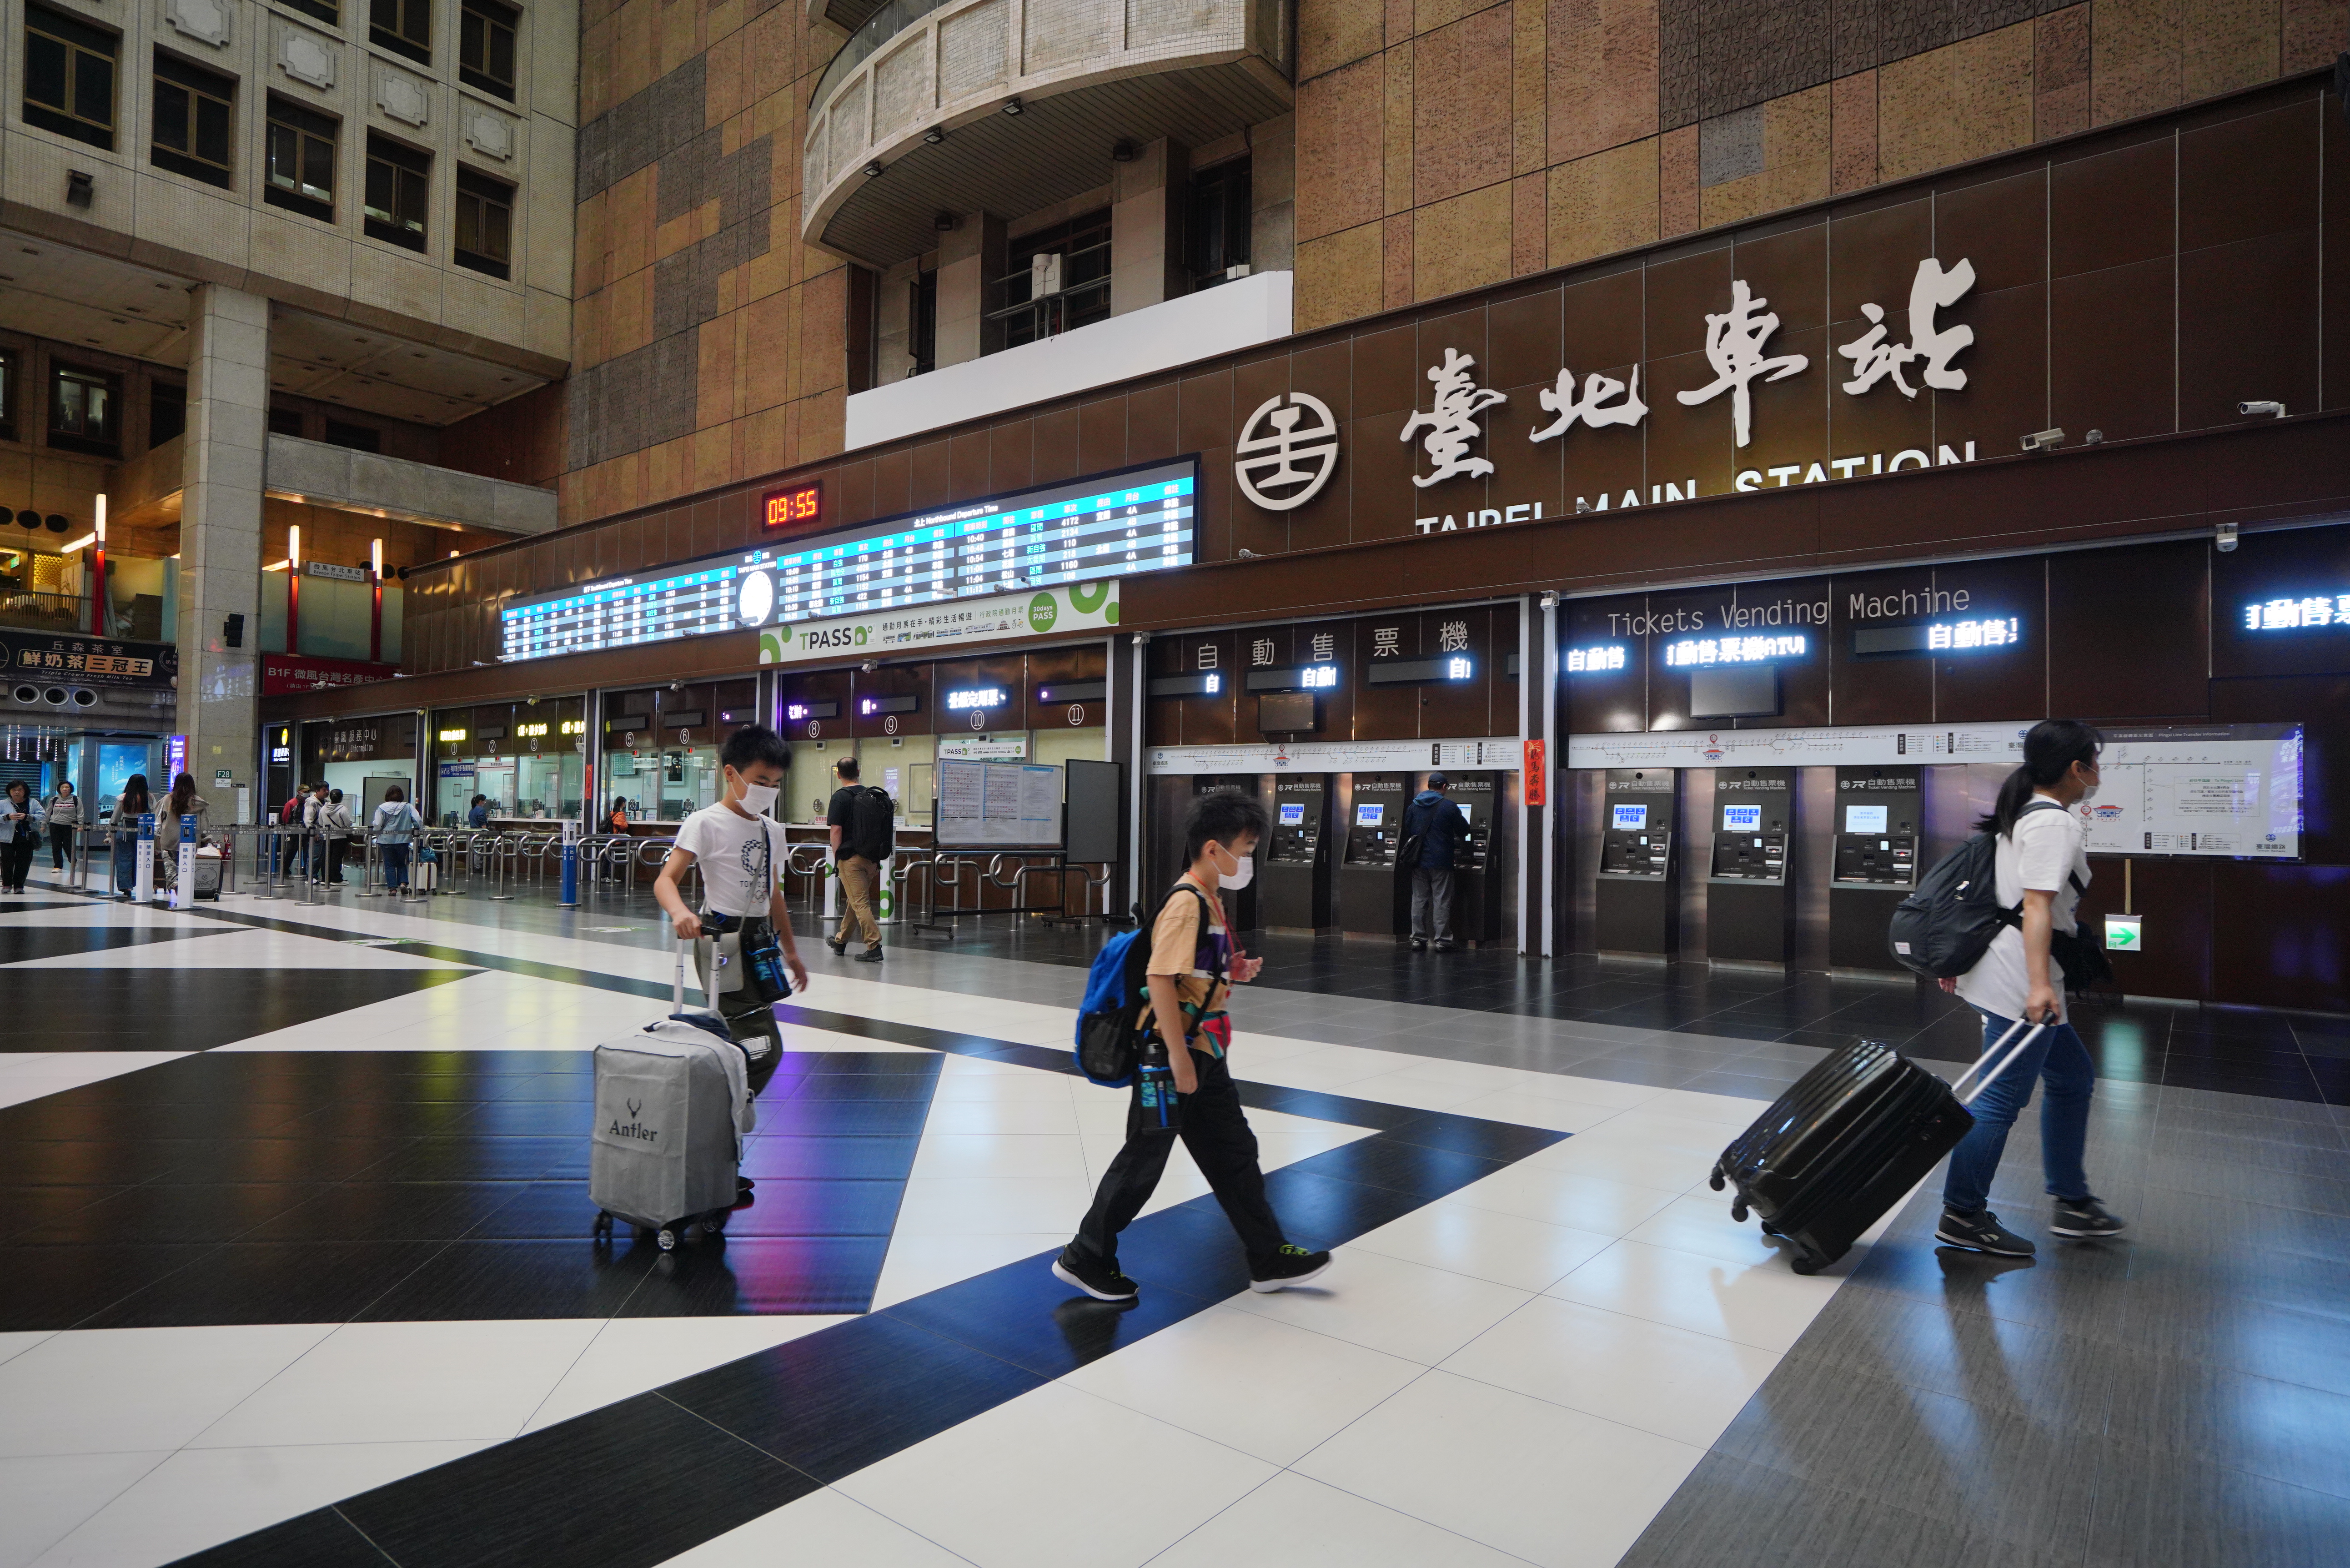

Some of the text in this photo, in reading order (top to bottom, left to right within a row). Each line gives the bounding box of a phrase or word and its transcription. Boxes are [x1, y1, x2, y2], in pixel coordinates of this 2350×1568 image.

[768, 490, 815, 524] 09:55
[914, 505, 998, 528] 北上 Northbound Departure Time
[964, 484, 1179, 532] 開車時刻 開往 車種 車次 經由 月台 備註
[967, 534, 984, 543] 10:40
[1031, 523, 1043, 533] 區間
[1061, 517, 1079, 526] 4172
[1127, 506, 1137, 514] 4A
[859, 543, 868, 551] 車次
[904, 534, 914, 543] 月台
[934, 529, 944, 538] 備註
[967, 544, 984, 553] 10:48
[1030, 533, 1042, 543] 區間
[1061, 528, 1078, 538] 2134
[1127, 518, 1137, 526] 4B
[967, 554, 983, 563] 10:54
[1027, 543, 1045, 554] 新自強
[1064, 538, 1076, 548] 110
[1126, 529, 1137, 537] 4A
[760, 561, 777, 569] STATION
[966, 565, 983, 573] 11:00
[1027, 554, 1045, 565] 太魯閣
[1063, 549, 1076, 558] 218
[1127, 540, 1136, 548] 4B
[314, 563, 361, 576] 微風台北車站
[786, 568, 799, 576] 10:00
[786, 576, 798, 584] 10:05
[856, 564, 869, 572] 4026
[966, 575, 983, 584] 11:04
[1029, 565, 1042, 575] 區間
[1061, 560, 1078, 569] 1160
[1126, 552, 1136, 560] 4A
[785, 573, 869, 593] 10:10 1154
[966, 585, 983, 594] 11:13
[1063, 571, 1075, 580] 108
[1126, 563, 1136, 571] 4A
[785, 583, 869, 603] 10:25 1152
[857, 592, 867, 600] 422
[785, 612, 797, 620] 10:35
[980, 606, 1024, 618] 行政院通勤月票
[1033, 612, 1053, 620] PASS
[1608, 587, 1969, 637] Tickets Vending Machine
[52, 641, 123, 655] 丘森茶室
[799, 627, 851, 650] TPASS
[1198, 621, 1467, 669] 自動售票機
[22, 651, 149, 674] 鮮奶茶三冠王
[268, 667, 291, 677] B1F
[1206, 674, 1219, 693] 自
[334, 728, 377, 743] 臺鐵服務中心
[351, 744, 373, 752] Information
[570, 850, 573, 860] 出口
[609, 1119, 658, 1141] Antler
